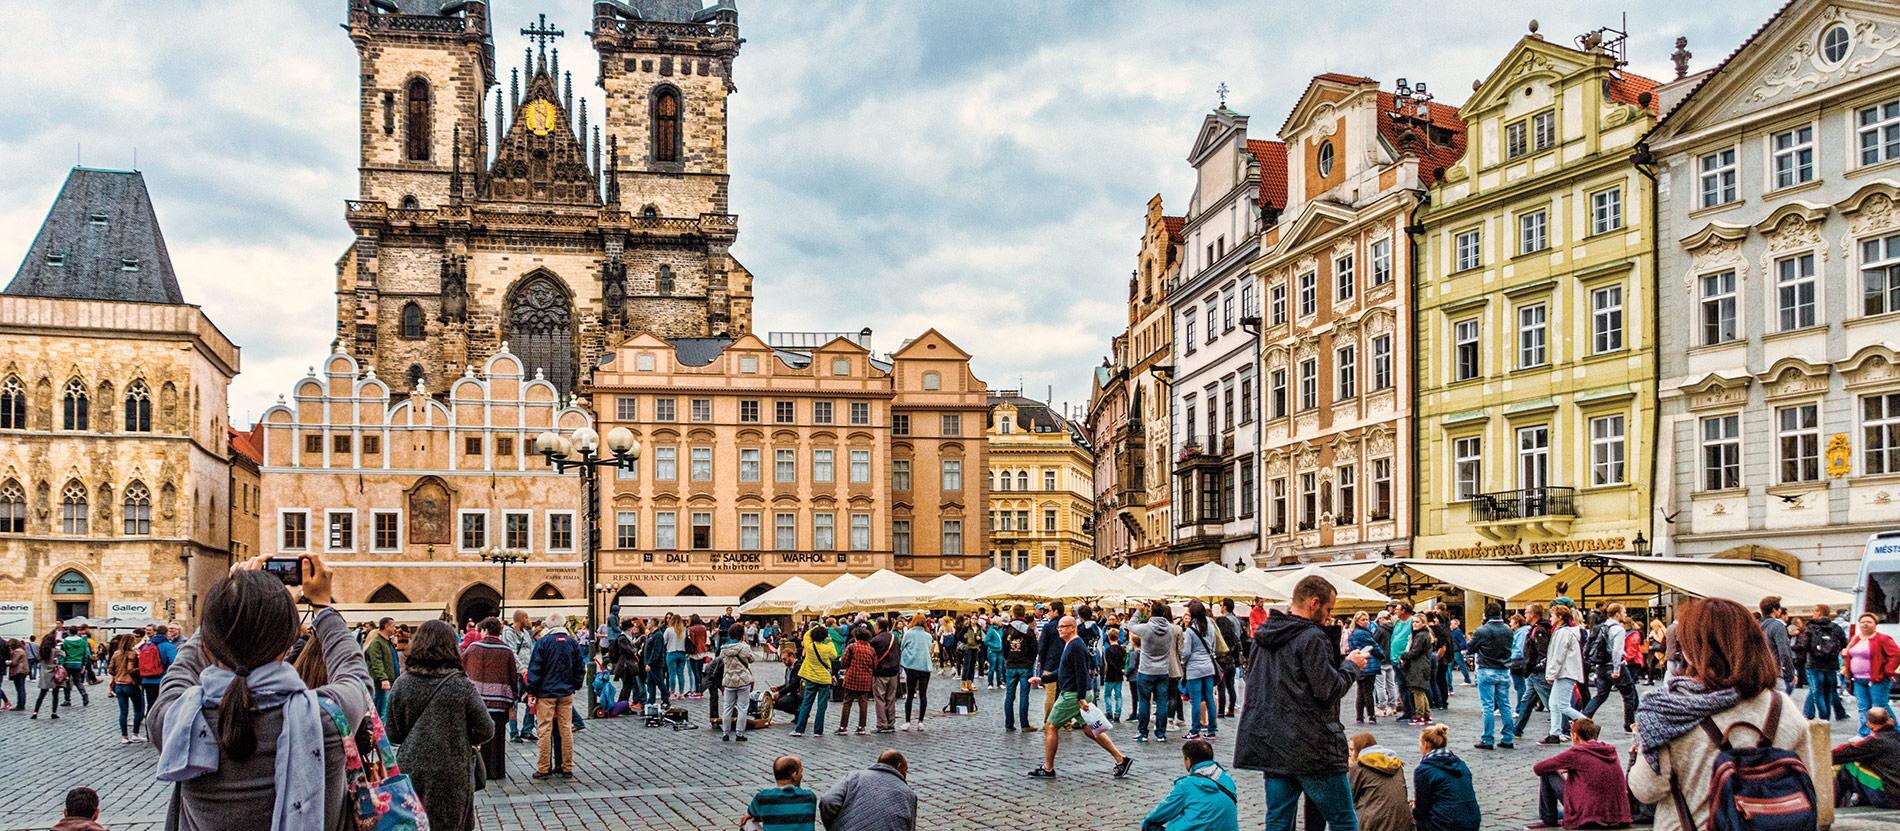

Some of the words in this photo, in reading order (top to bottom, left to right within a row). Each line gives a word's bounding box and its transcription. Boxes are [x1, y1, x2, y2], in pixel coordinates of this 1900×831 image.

[1529, 536, 1624, 554] RESTAURACE
[723, 553, 760, 562] SAUDEK
[782, 553, 825, 562] WARHOL
[0, 603, 29, 611] alerie
[112, 604, 147, 612] Gallery
